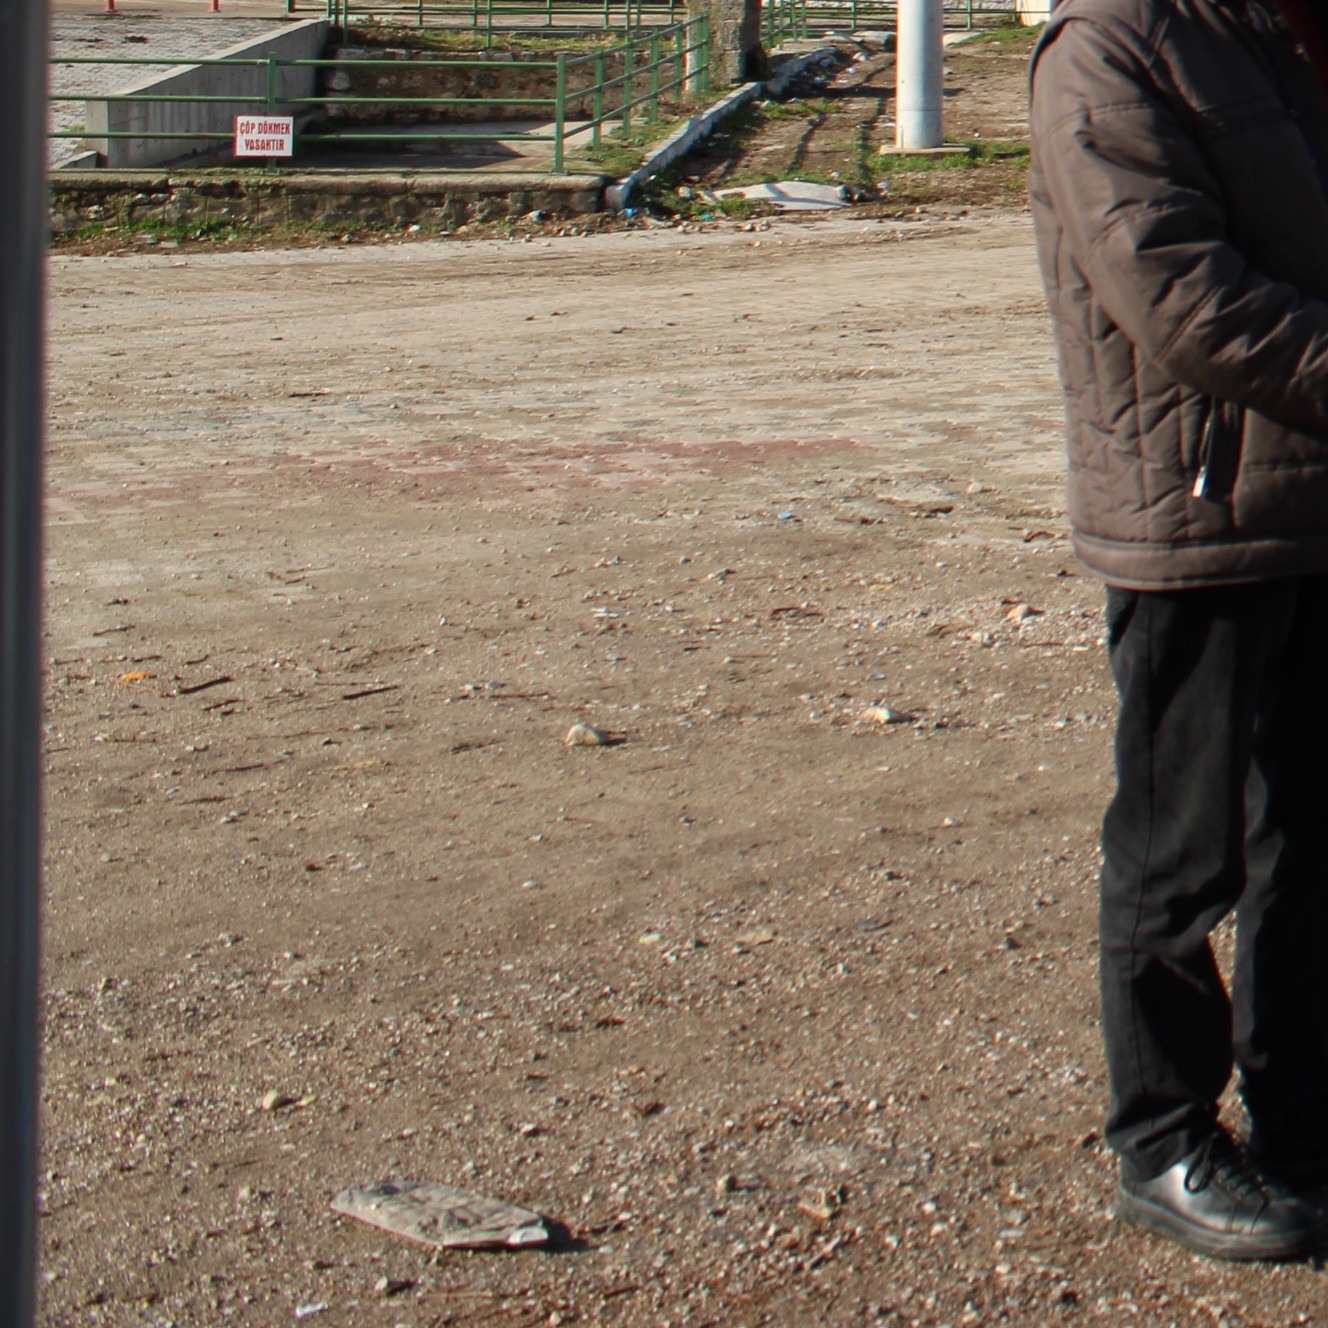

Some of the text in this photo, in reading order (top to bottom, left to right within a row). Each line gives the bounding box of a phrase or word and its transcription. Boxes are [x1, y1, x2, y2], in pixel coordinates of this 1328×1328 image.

[240, 121, 290, 136] ÇÖP DÖKMEK
[245, 138, 285, 151] YASAKTIR
